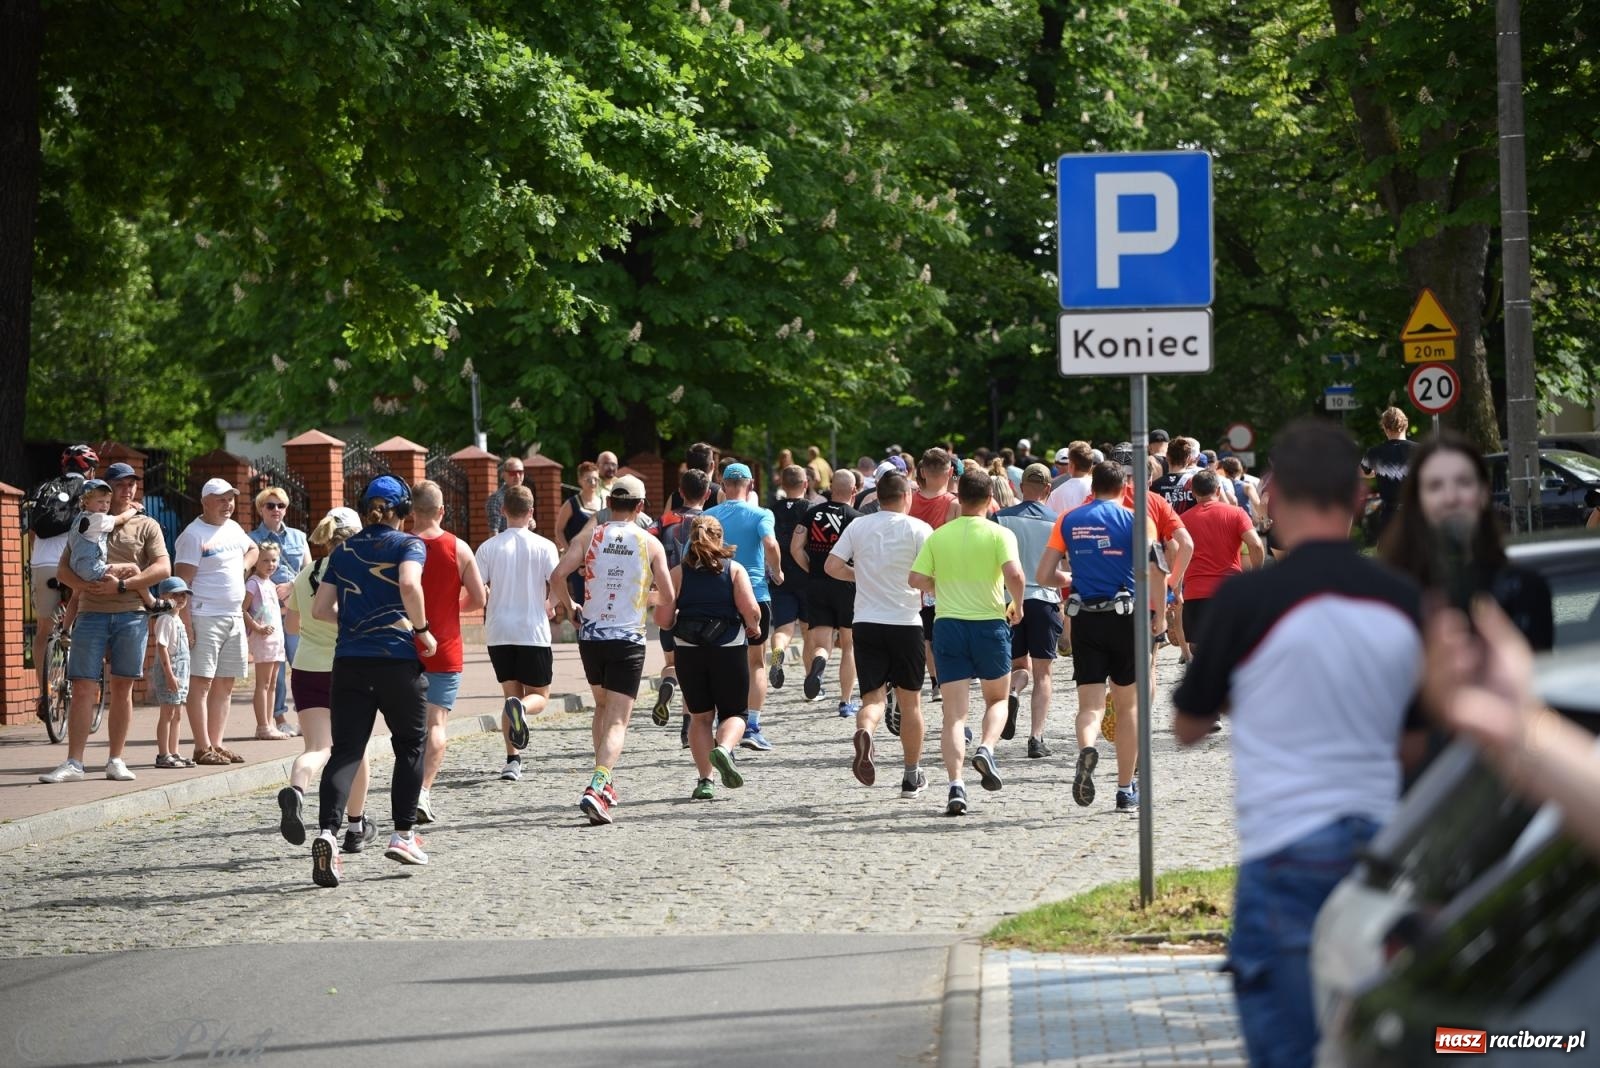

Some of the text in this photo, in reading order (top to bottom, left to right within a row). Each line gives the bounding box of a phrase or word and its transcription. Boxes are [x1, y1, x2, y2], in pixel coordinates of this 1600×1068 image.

[1095, 171, 1180, 289] P
[1073, 328, 1199, 359] Koniec
[1418, 375, 1453, 401] 20
[1165, 490, 1193, 503] ASSIC
